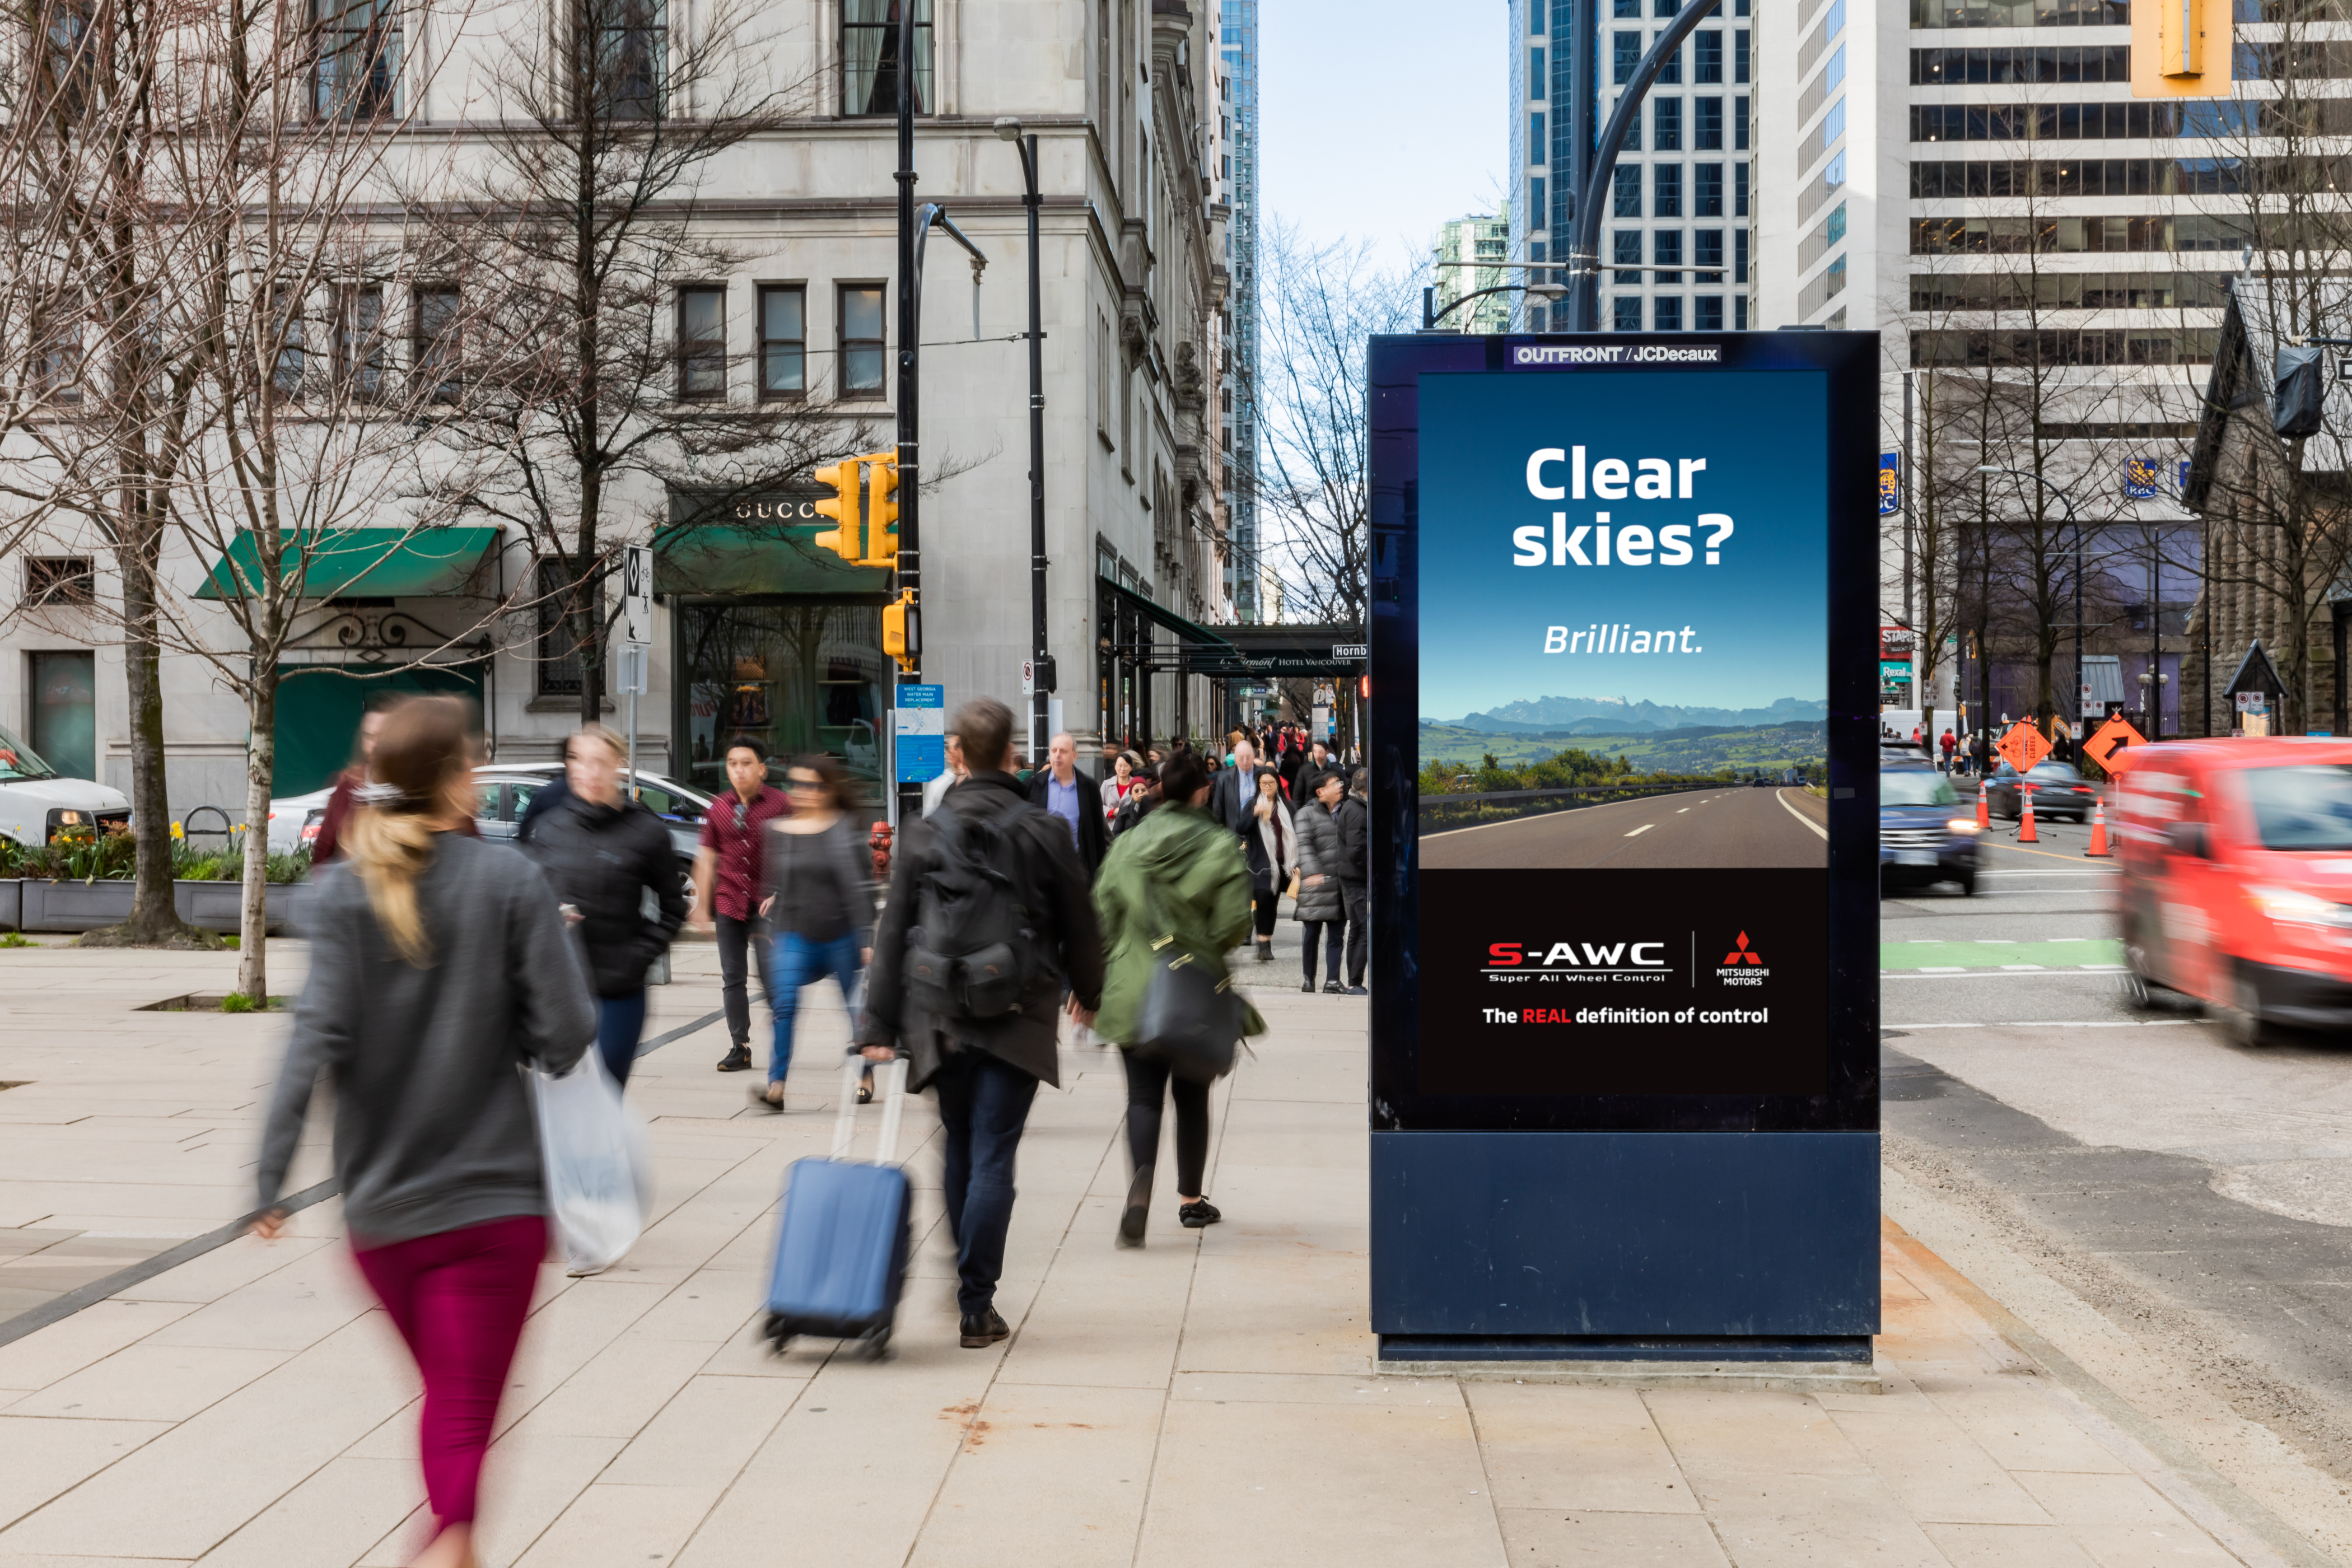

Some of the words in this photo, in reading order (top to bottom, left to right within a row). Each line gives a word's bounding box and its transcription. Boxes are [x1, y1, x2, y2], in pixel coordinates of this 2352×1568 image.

[1518, 347, 1623, 363] OUTFRONT
[1634, 346, 1717, 361] JCDecaux
[1526, 445, 1706, 500] Clear
[736, 502, 824, 519] GUCC
[1513, 511, 1734, 567] skies?
[1543, 624, 1702, 654] Brilliant.
[1336, 646, 1366, 656] Hornb
[1883, 666, 1906, 677] Rexall
[1489, 942, 1664, 965] S-AWC
[1489, 974, 1530, 983] Super
[1716, 968, 1769, 977] MITSUBISHI
[1724, 977, 1762, 986] MOTORS
[1482, 1009, 1518, 1023] The
[1523, 1009, 1571, 1023] REAL
[1576, 1006, 1670, 1023] definition
[1674, 1006, 1695, 1023] of
[1699, 1008, 1768, 1023] control
